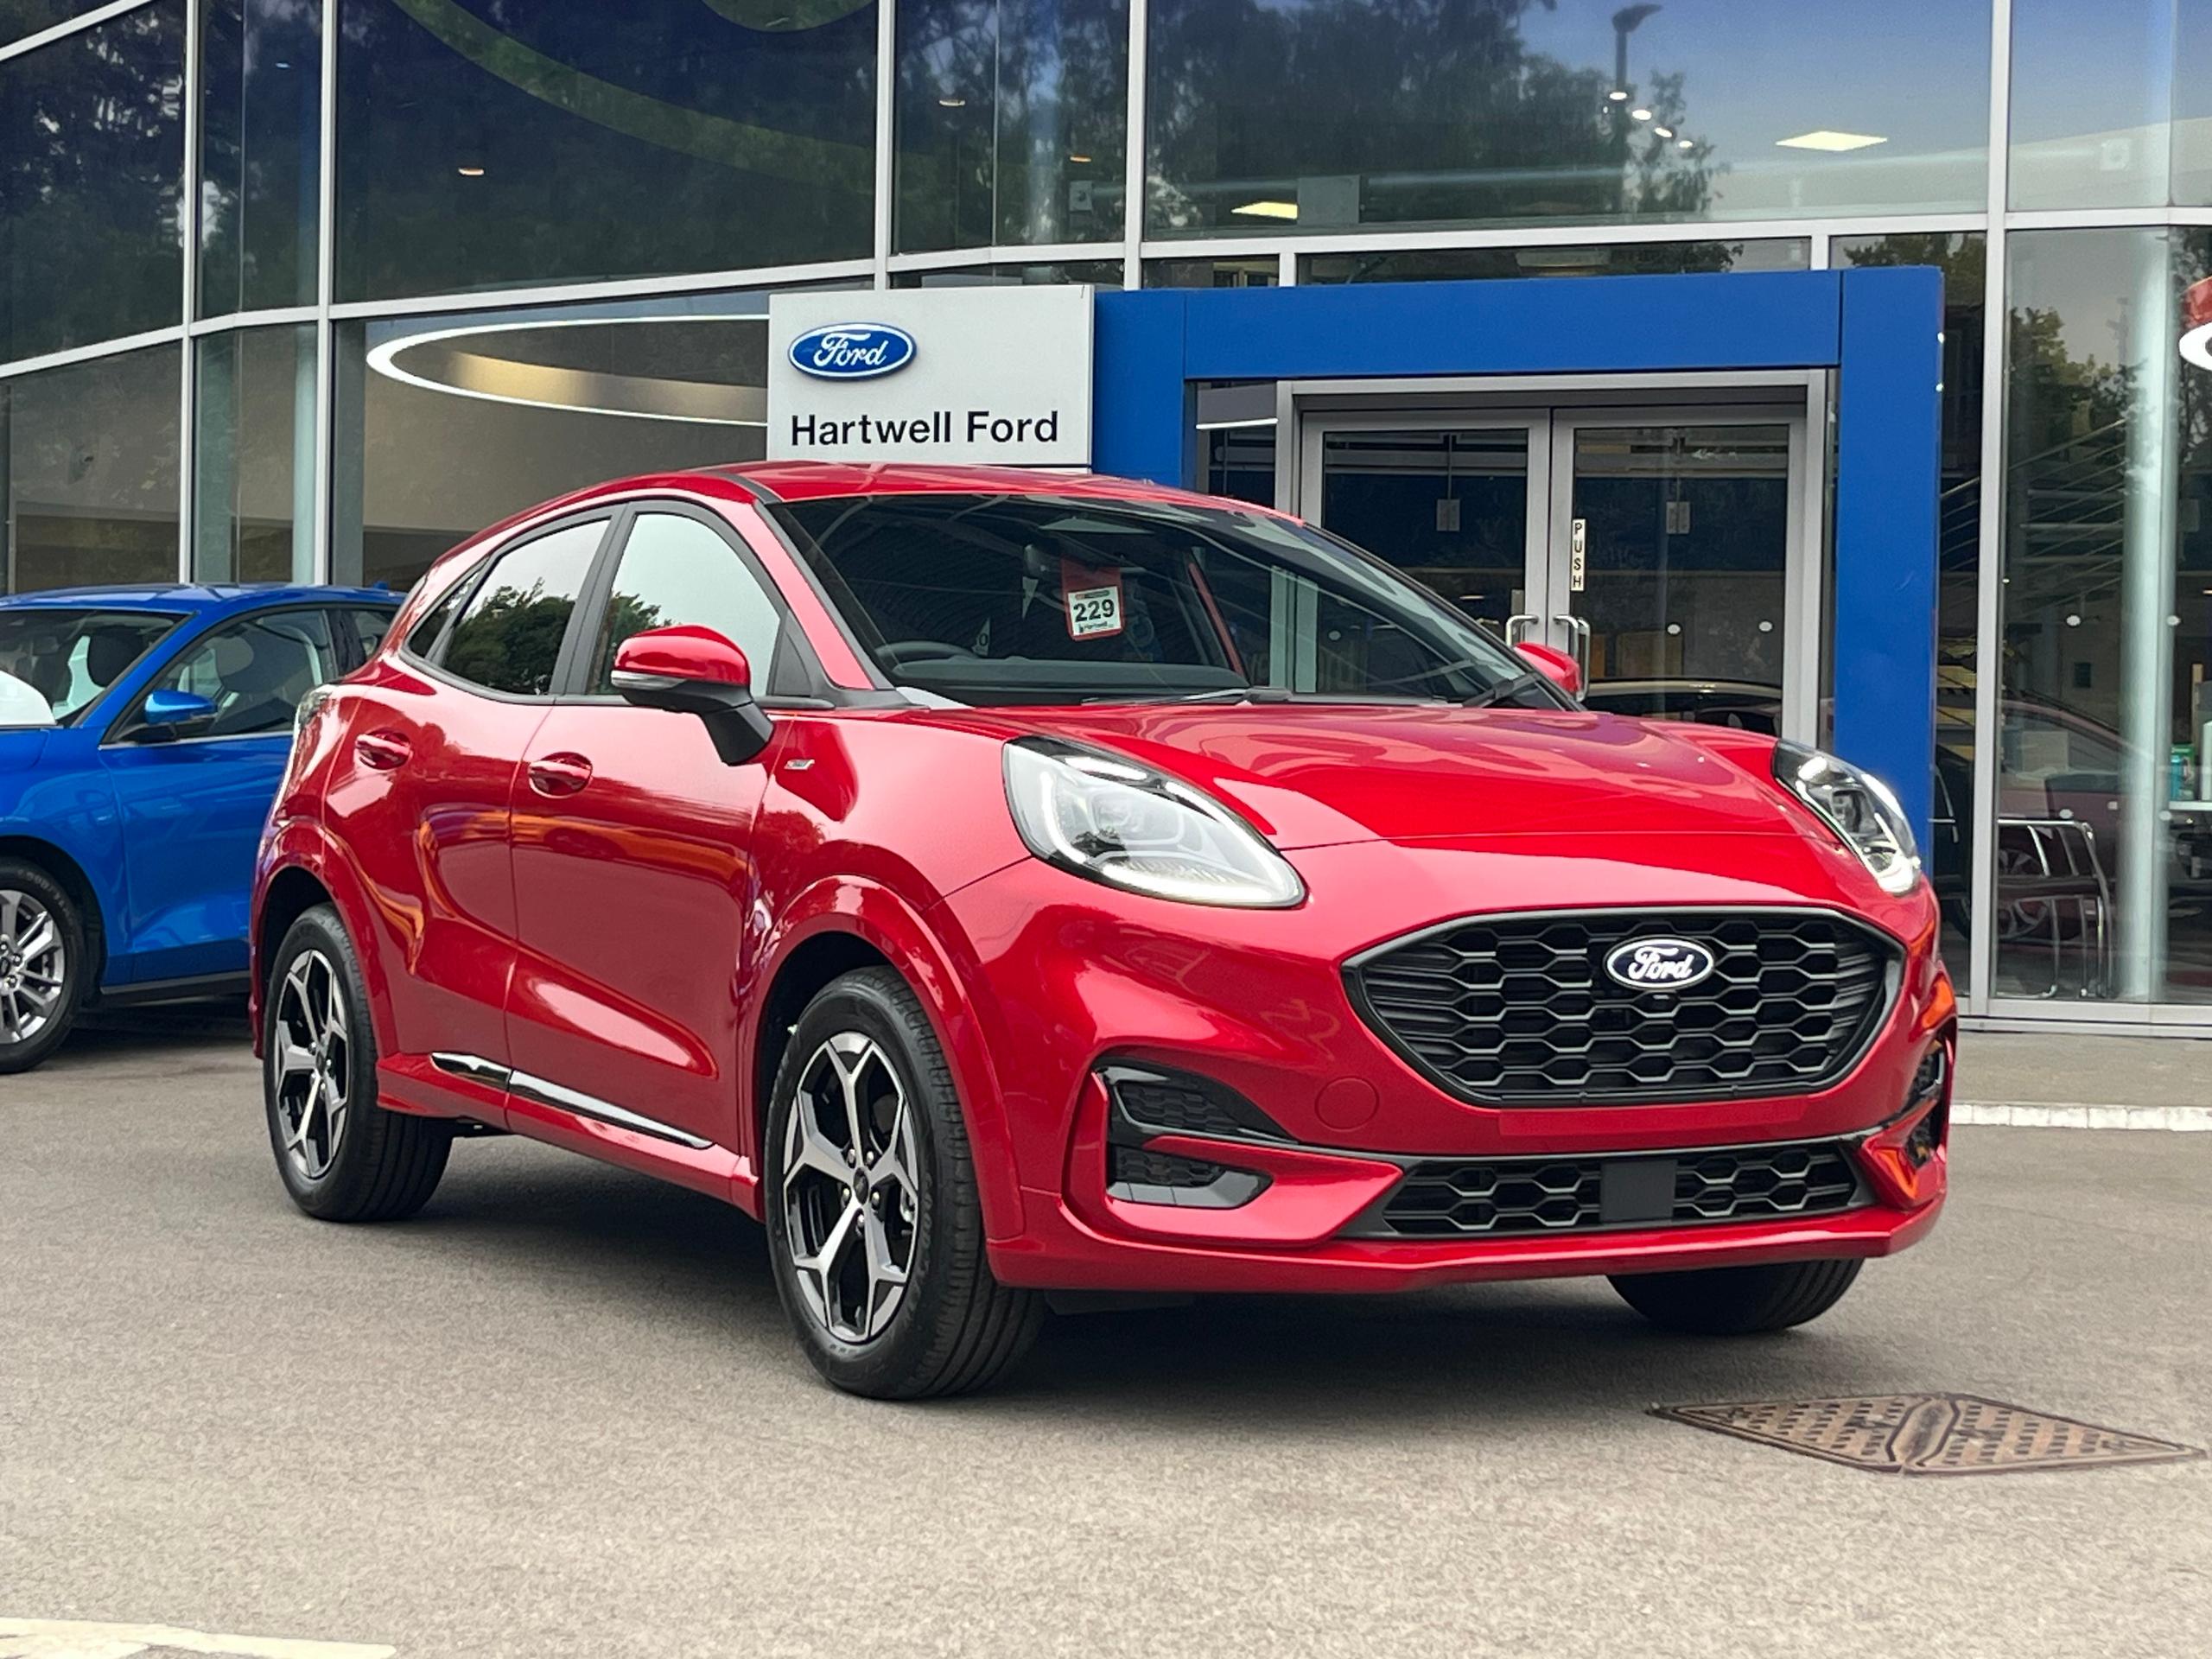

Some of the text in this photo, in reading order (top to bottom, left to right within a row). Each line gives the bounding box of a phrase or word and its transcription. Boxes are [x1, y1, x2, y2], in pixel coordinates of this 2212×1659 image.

[813, 332, 888, 367] Ford
[791, 410, 1058, 446] Hartwell Ford
[1573, 521, 1583, 588] PUSH
[1073, 599, 1115, 622] 229
[1628, 945, 1694, 980] Ford
